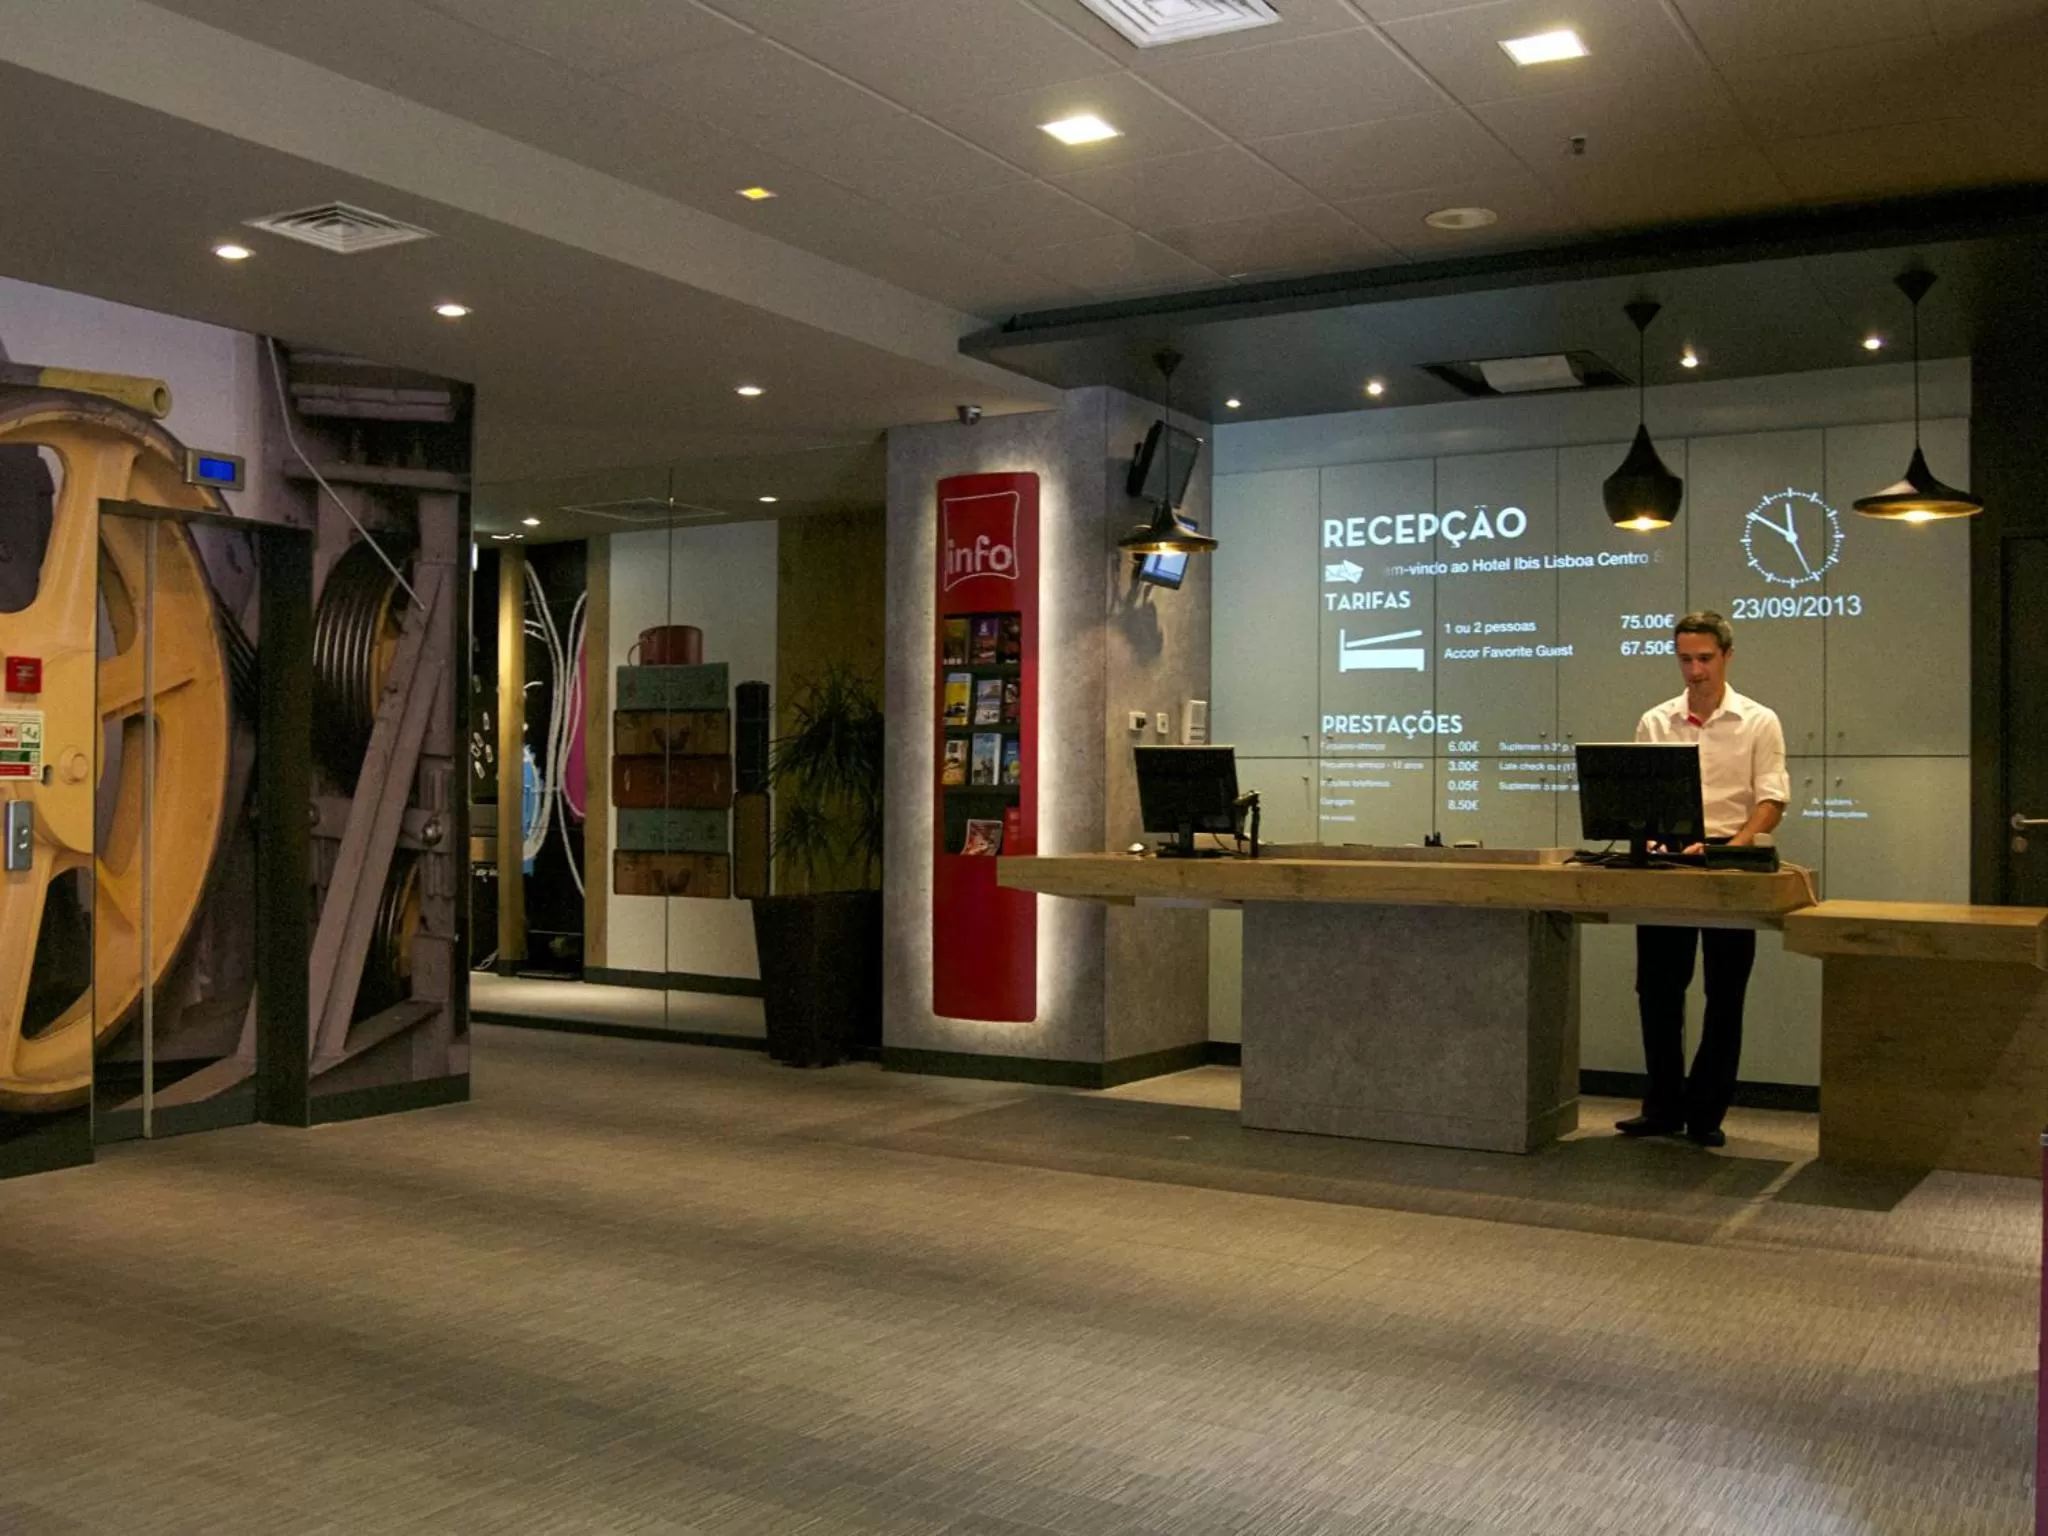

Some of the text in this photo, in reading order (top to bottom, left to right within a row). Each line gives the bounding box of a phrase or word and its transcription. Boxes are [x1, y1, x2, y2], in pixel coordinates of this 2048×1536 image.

[1324, 505, 1527, 549] RECEPÇÃO
[946, 535, 1012, 574] info
[1450, 562, 1469, 573] ao
[1472, 557, 1511, 572] Hotel
[1514, 556, 1540, 571] Ibis
[1544, 554, 1594, 569] Lisboa
[1597, 551, 1650, 567] Centro
[1324, 590, 1411, 611] TARIFAS
[1731, 594, 1862, 620] 23/09/2013
[1444, 613, 1675, 635] 1 ou 2 pessoas 75.00€
[1444, 640, 1675, 659] Accor Favorite Guest 67.50€
[1322, 709, 1463, 739] PRESTAÇÕES
